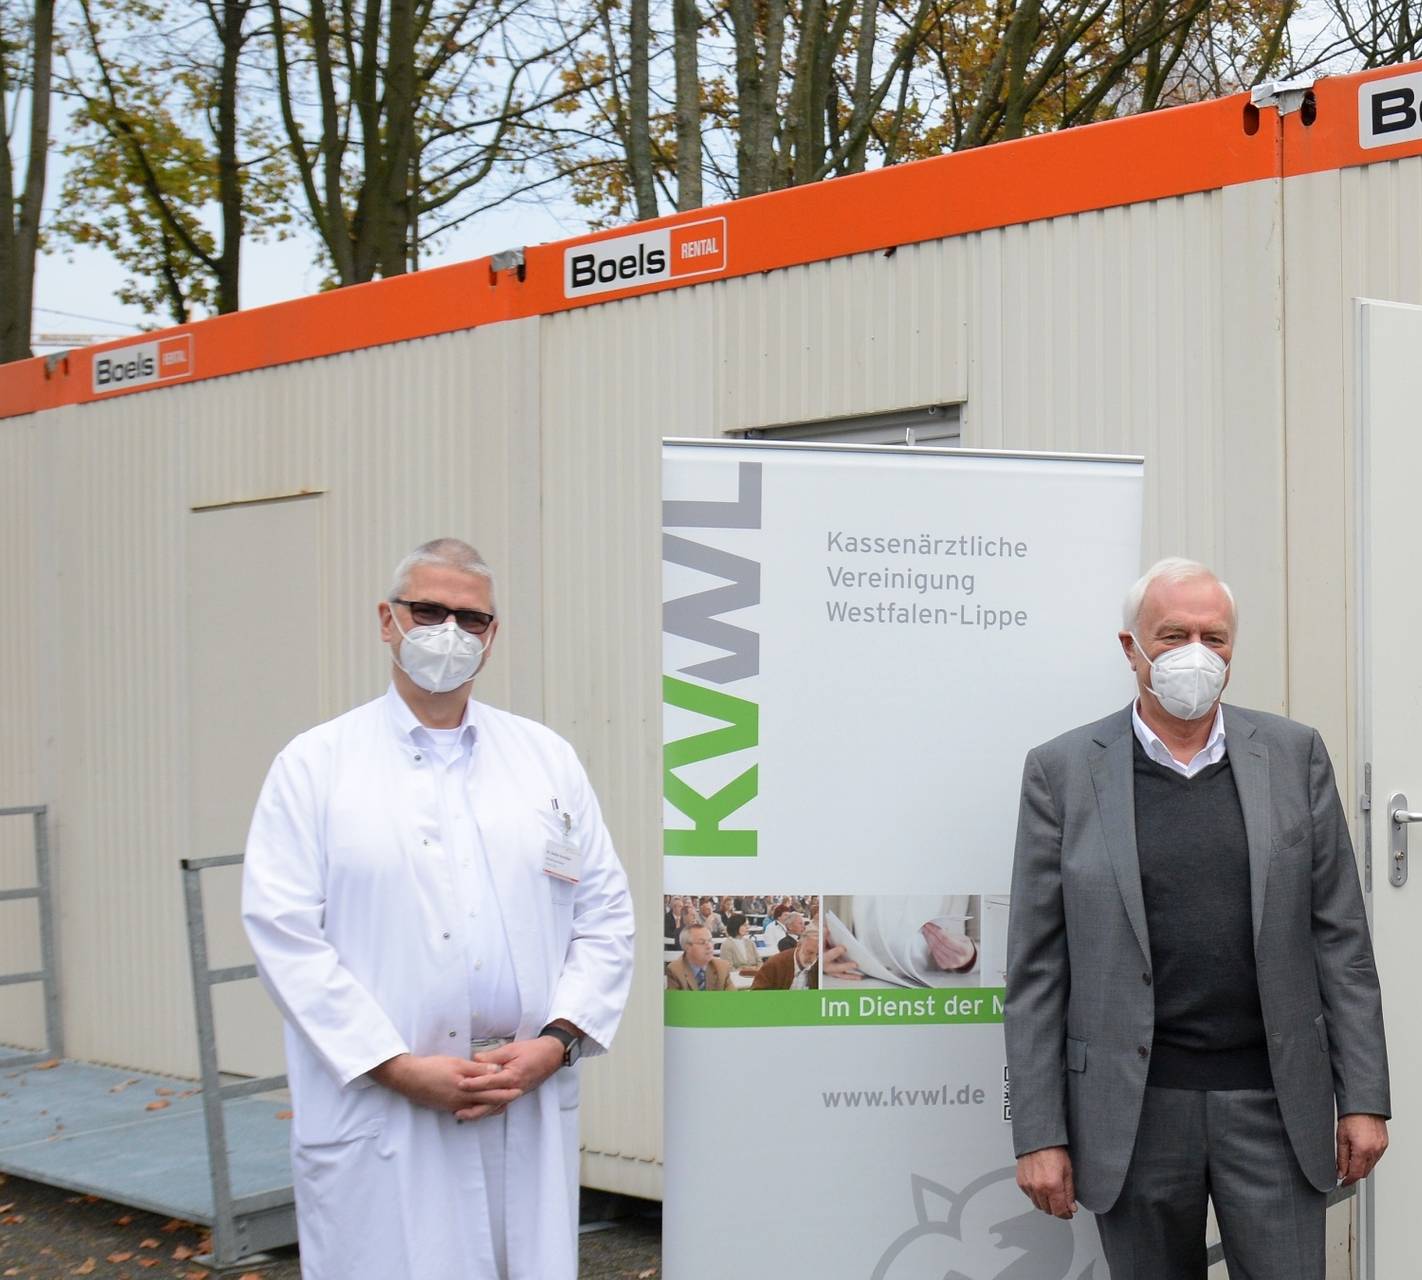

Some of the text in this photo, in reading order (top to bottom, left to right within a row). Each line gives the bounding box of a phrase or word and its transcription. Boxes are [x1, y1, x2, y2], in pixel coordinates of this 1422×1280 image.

[571, 237, 719, 288] Boels RENTAL
[97, 352, 154, 385] Boels
[827, 531, 1028, 557] Kassenärztliche
[826, 566, 975, 595] Vereinigung
[826, 601, 1028, 630] Westfalen-Lippe
[821, 997, 849, 1017] Im
[859, 995, 935, 1017] Dienst
[944, 994, 983, 1016] der
[822, 1084, 985, 1109] www.kvwl.de
